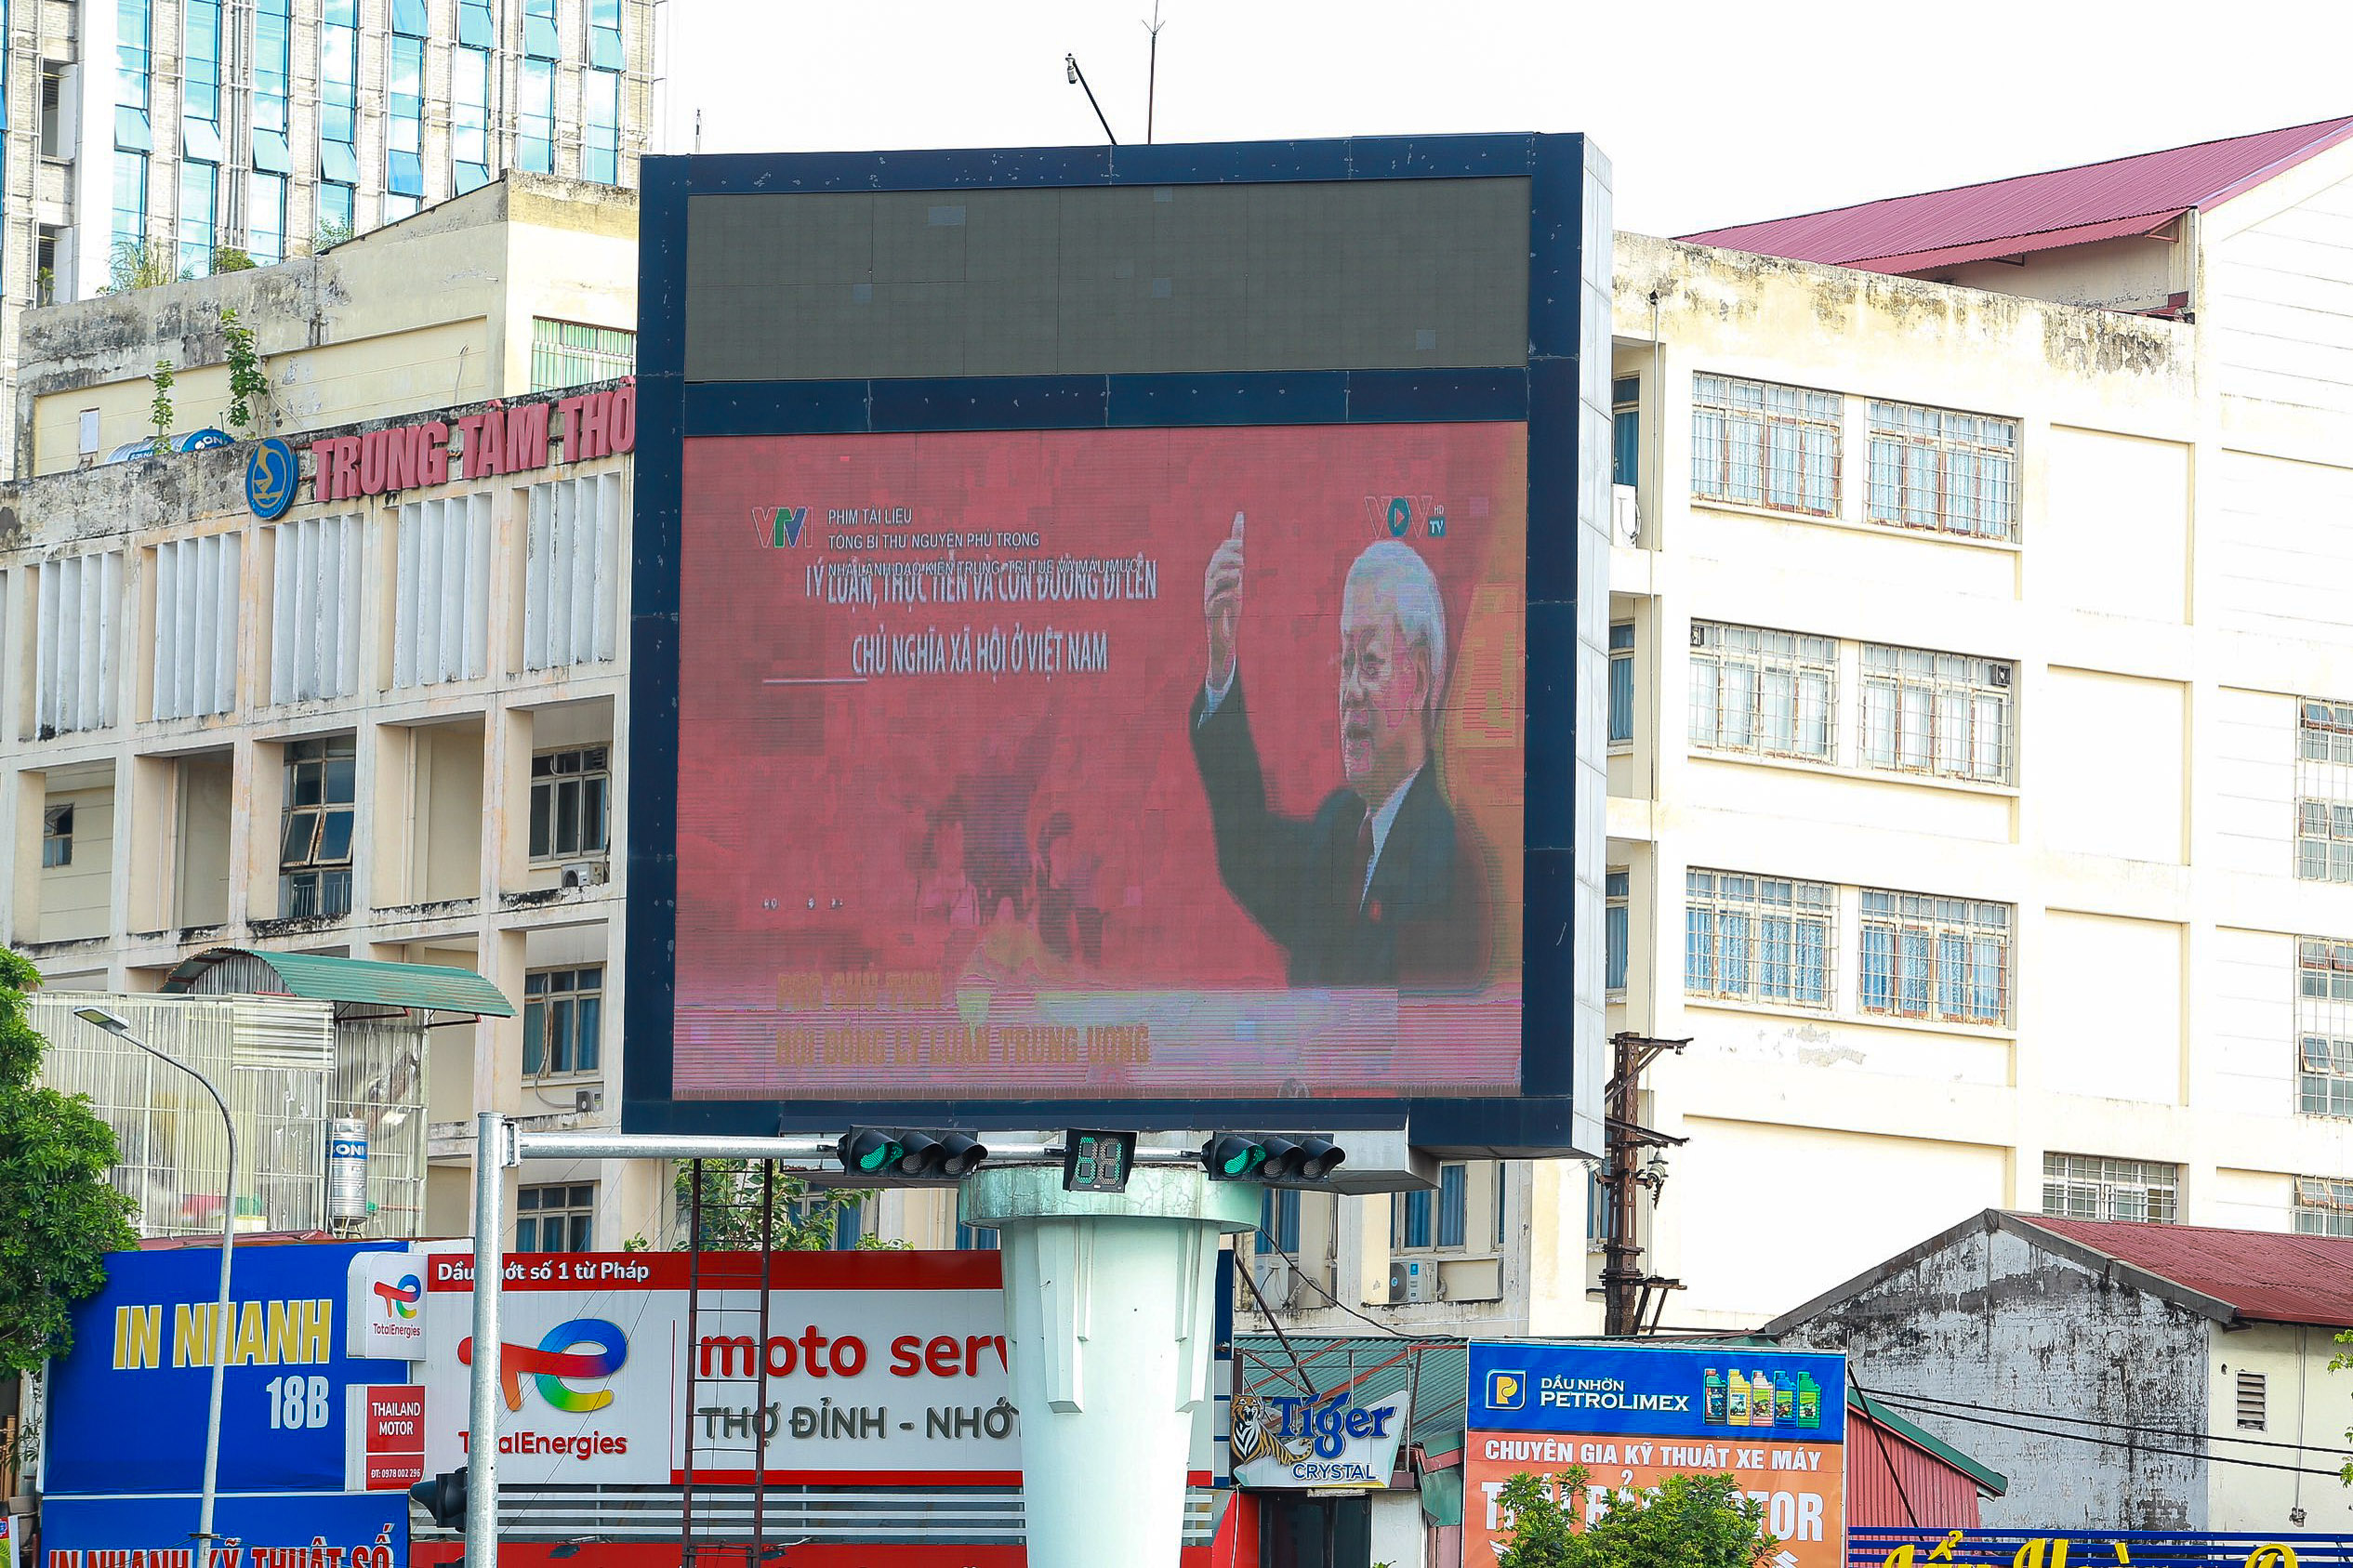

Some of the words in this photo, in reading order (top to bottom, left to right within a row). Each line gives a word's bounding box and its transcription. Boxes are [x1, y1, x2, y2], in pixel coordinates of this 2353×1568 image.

[311, 421, 449, 502] TRUNG
[458, 399, 549, 480] TÂM
[828, 508, 858, 525] PHIM
[862, 505, 881, 525] TÀI
[1429, 520, 1444, 534] TV
[996, 532, 1039, 550] TRỌNG
[852, 623, 888, 675] CHỦ
[892, 625, 946, 675] NGHĨA
[950, 624, 972, 673] XÃ
[976, 625, 1007, 683] HỘI
[1011, 622, 1023, 672] Ở
[1026, 625, 1064, 683] VIỆT
[1067, 629, 1108, 674] NAM
[438, 1260, 475, 1281] Dầu
[530, 1259, 553, 1280] số
[558, 1263, 570, 1280] 1
[574, 1262, 597, 1280] từ
[601, 1260, 650, 1283] Pháp
[112, 1304, 163, 1370] IN
[172, 1298, 333, 1368] NHANH
[373, 1323, 421, 1338] TotalEnergies
[700, 1324, 867, 1377] moto
[266, 1375, 329, 1430] 18B
[371, 1402, 421, 1416] THAILAND
[1540, 1390, 1690, 1412] PETROLIMEX
[378, 1420, 414, 1436] MOTOR
[697, 1402, 781, 1447] THỢ
[788, 1397, 888, 1439] ĐỈNH
[926, 1396, 1022, 1439] NHỚ
[1271, 1391, 1398, 1459] Tiger
[457, 1430, 628, 1460] TalEnergies
[1485, 1438, 1574, 1463] CHUYÊN
[1580, 1443, 1619, 1464] GIA
[1624, 1442, 1654, 1465] KỸ
[1659, 1443, 1730, 1470] THUẬT
[1735, 1448, 1765, 1469] XE
[1771, 1447, 1822, 1471] MÁY
[381, 1469, 397, 1478] 0978
[397, 1469, 409, 1478] 002
[409, 1469, 421, 1478] 296
[1292, 1462, 1378, 1481] CRYSTAL
